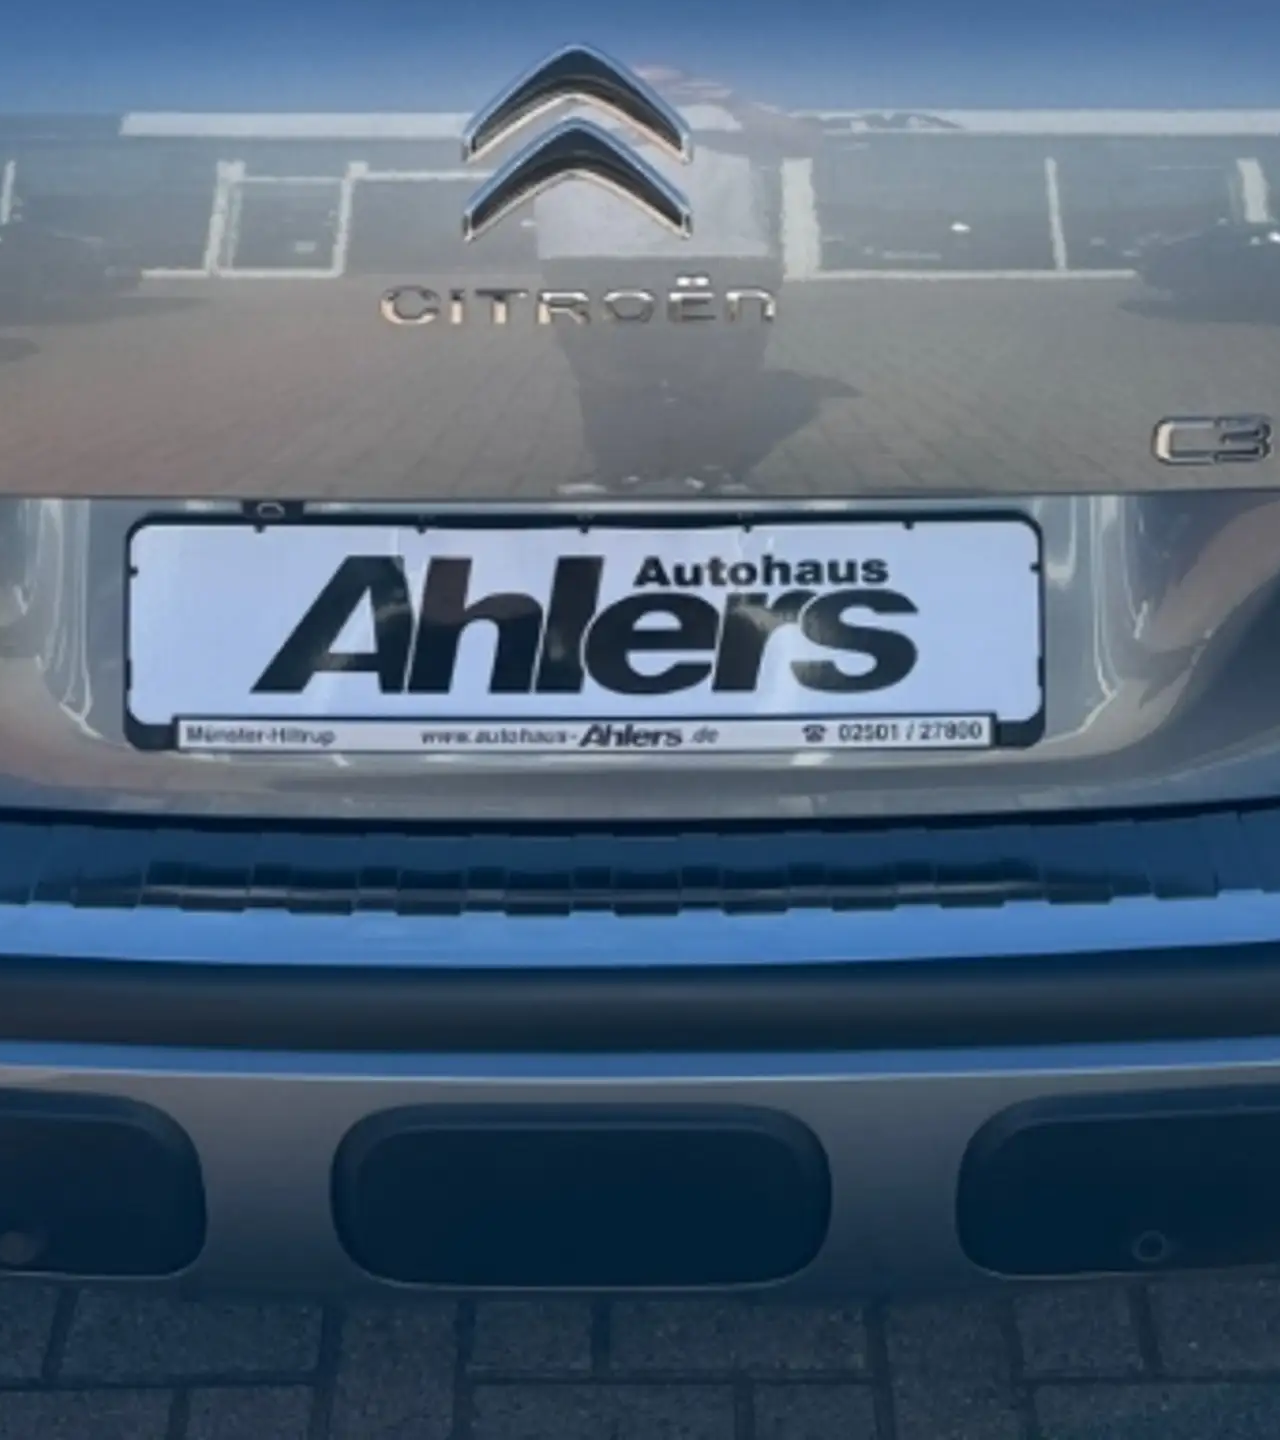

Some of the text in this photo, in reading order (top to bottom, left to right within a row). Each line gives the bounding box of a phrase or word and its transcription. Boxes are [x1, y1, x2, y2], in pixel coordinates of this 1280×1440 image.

[380, 274, 777, 326] CITROËN
[1154, 414, 1271, 465] C3
[633, 555, 889, 588] Autohaus
[249, 555, 918, 696] Ahlers
[838, 723, 900, 743] 02501
